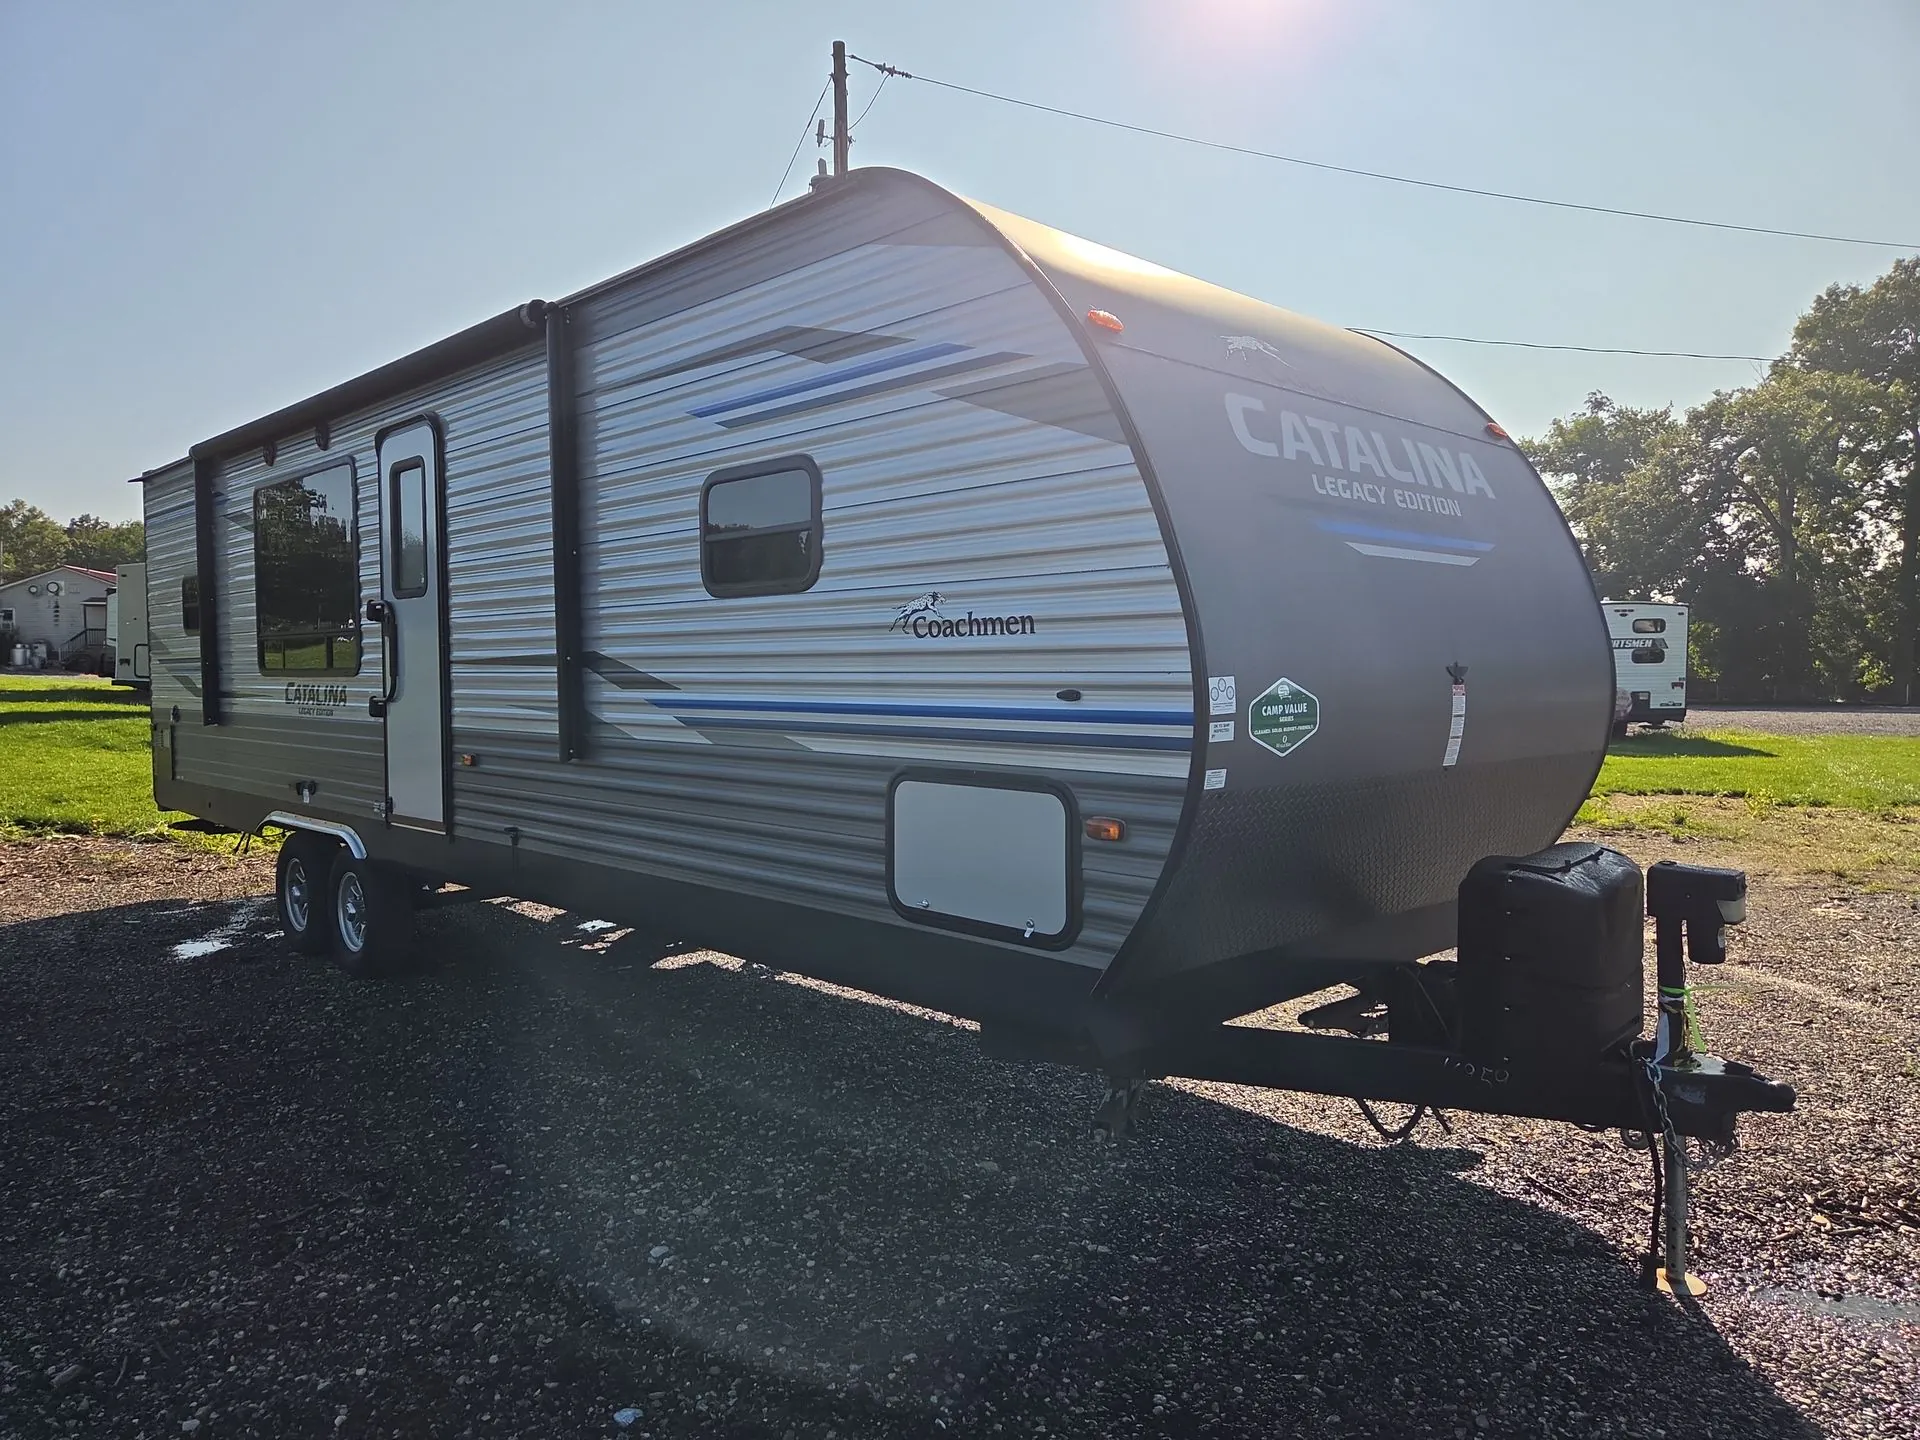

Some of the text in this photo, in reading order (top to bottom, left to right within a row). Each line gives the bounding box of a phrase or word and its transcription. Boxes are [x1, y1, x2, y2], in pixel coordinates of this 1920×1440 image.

[1225, 392, 1496, 499] CATALINA
[1311, 474, 1462, 517] LEGACY EDITION
[912, 611, 1036, 639] Coachmen
[1611, 639, 1653, 648] RTSMEN
[284, 681, 347, 706] CATALINA
[1261, 702, 1308, 717] CAMP VALUE
